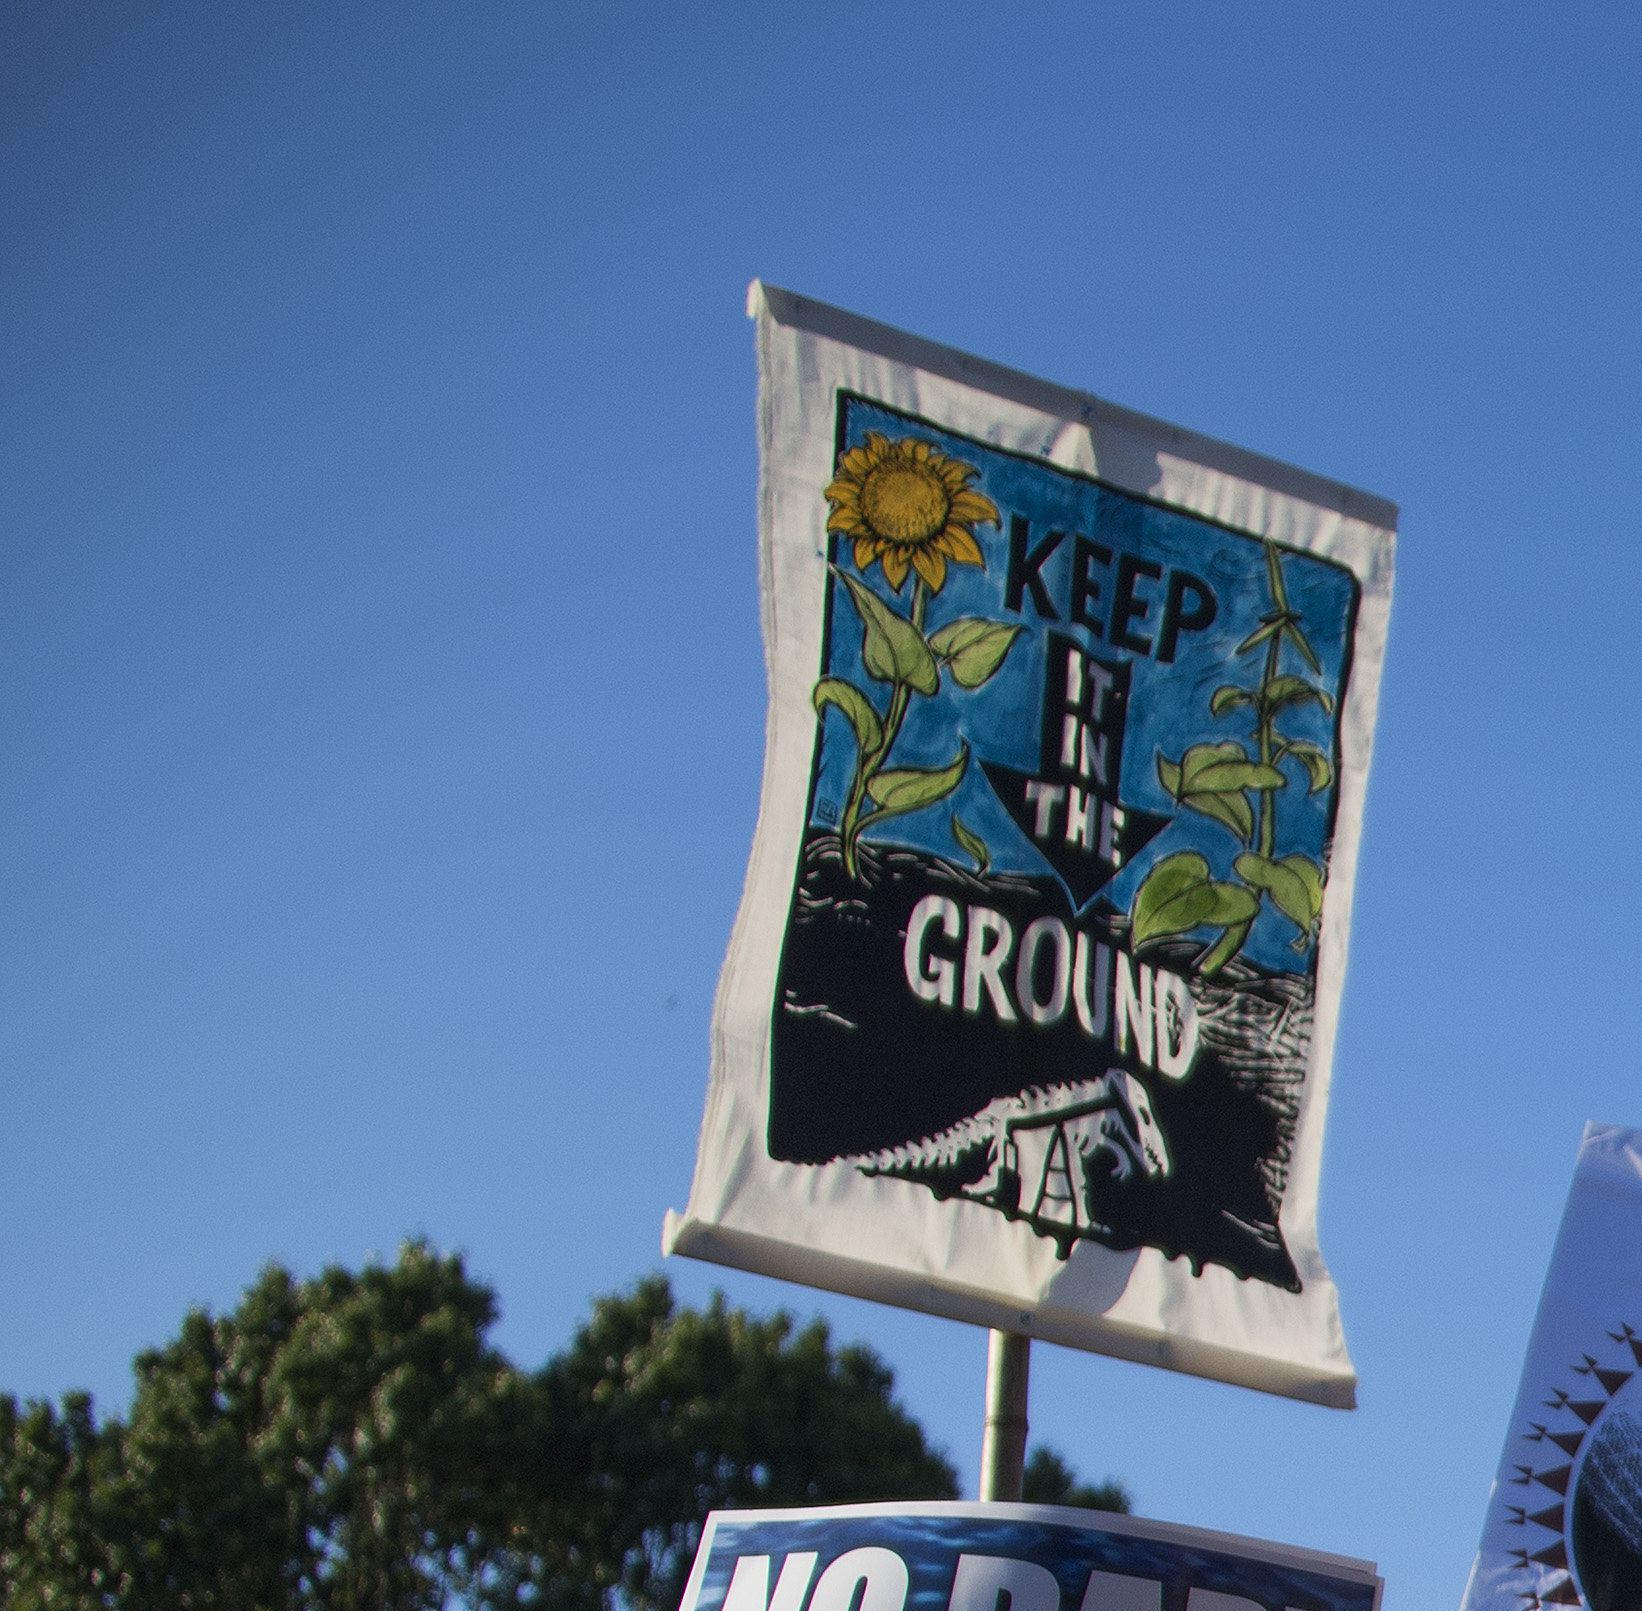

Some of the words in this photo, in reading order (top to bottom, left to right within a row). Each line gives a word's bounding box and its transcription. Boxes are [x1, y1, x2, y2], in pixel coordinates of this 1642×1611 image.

[1004, 512, 1220, 664] KEEP
[1066, 647, 1115, 722] IT
[1060, 712, 1109, 787] IN
[1025, 778, 1127, 869] THE
[904, 893, 1201, 1079] GROUND
